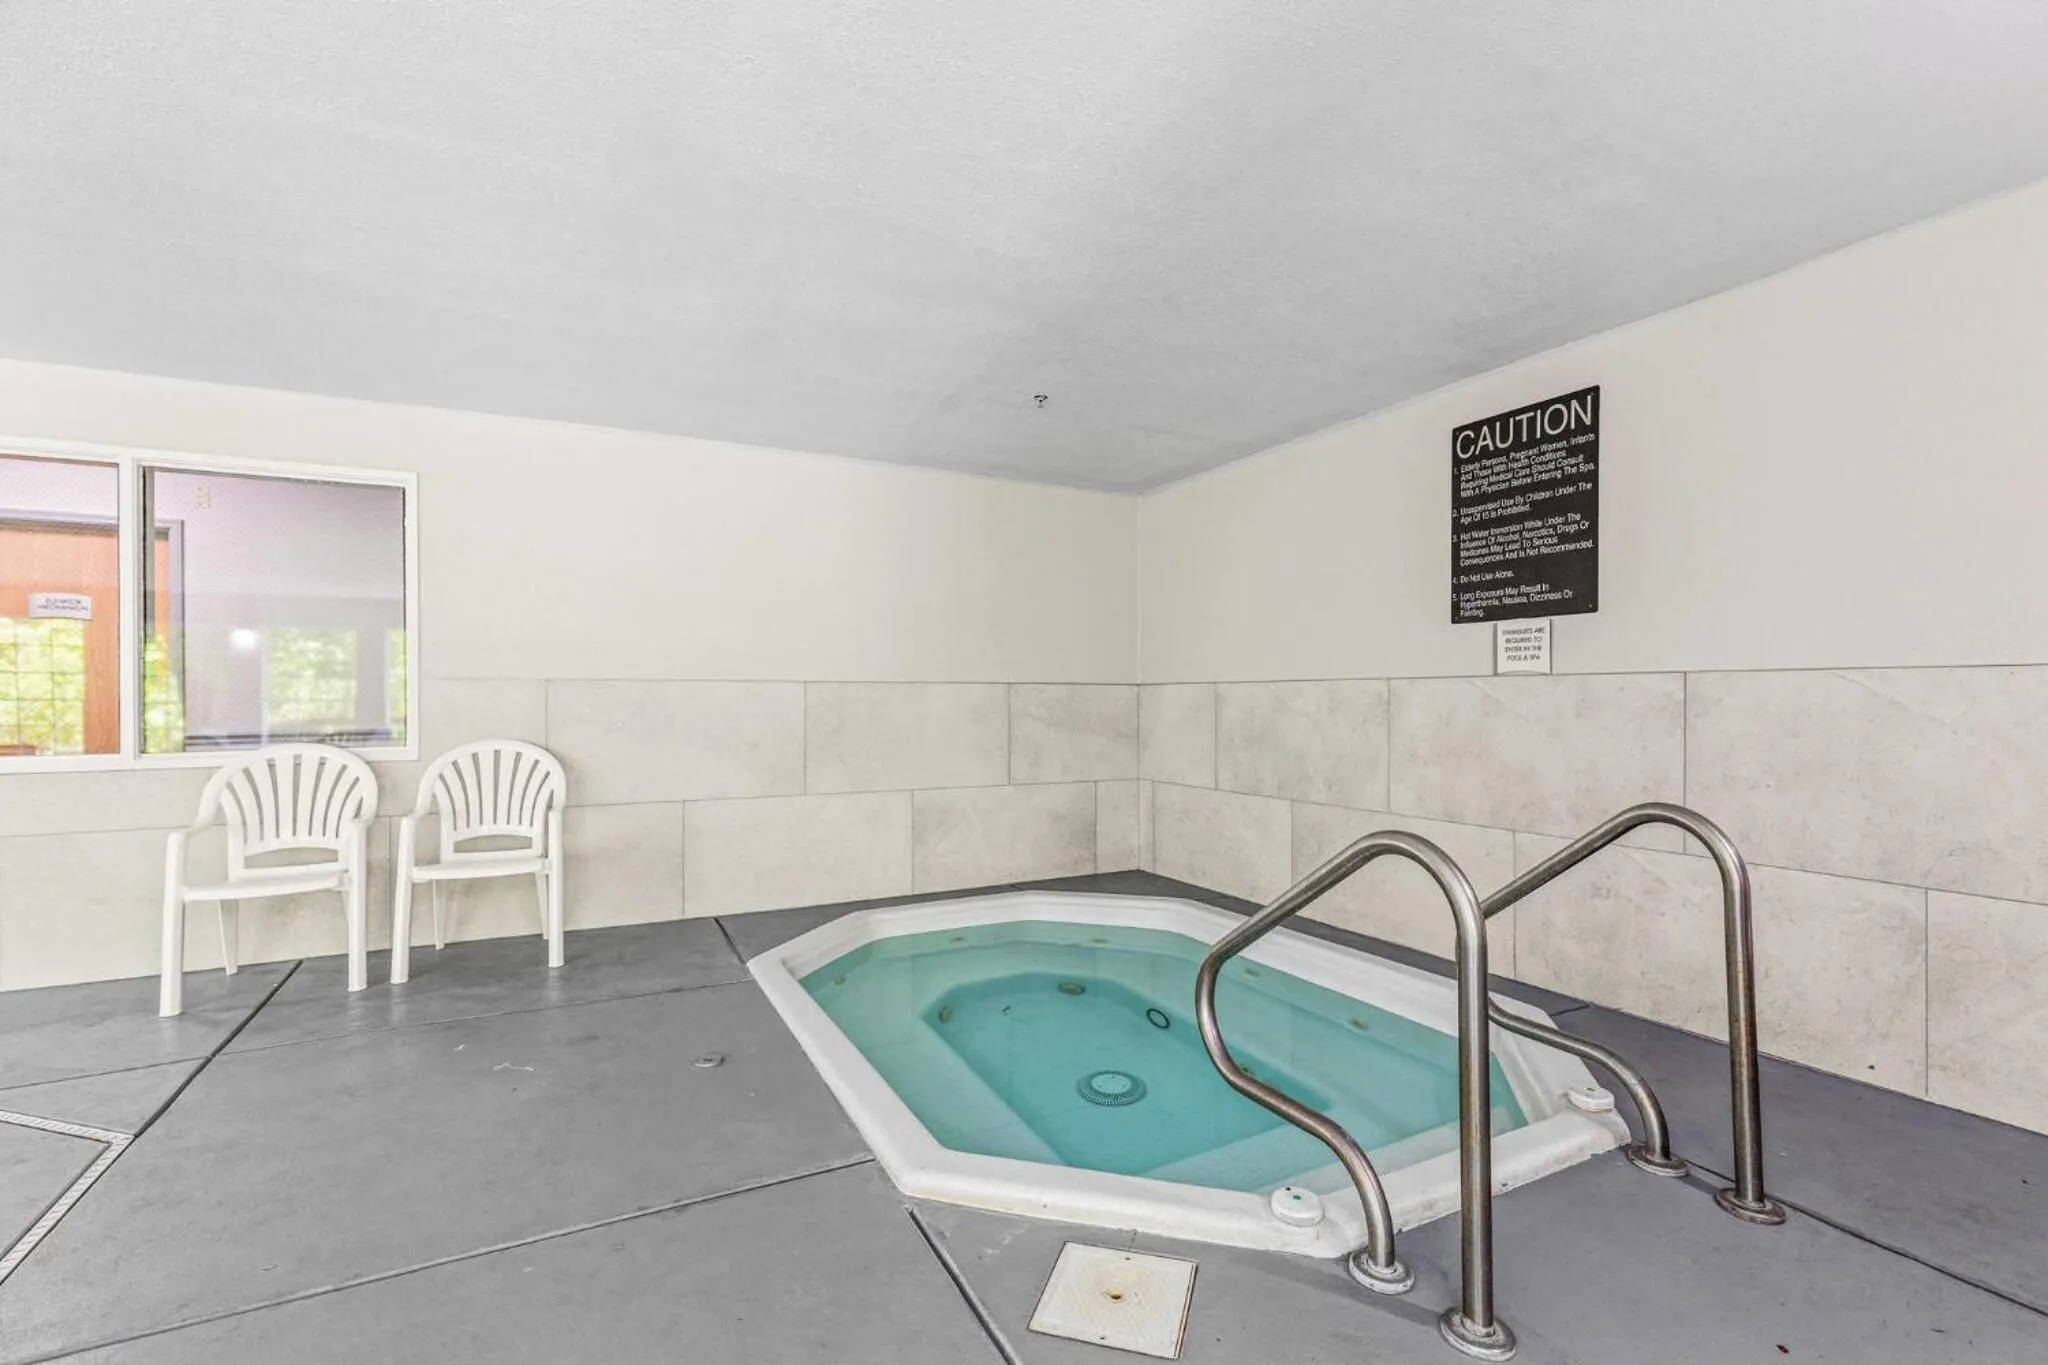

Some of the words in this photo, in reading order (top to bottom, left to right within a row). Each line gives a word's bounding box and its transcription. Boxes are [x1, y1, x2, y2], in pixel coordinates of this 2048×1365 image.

[1456, 395, 1592, 459] CAUTION
[1510, 446, 1539, 461] Pregnant
[1461, 471, 1472, 482] And
[1474, 469, 1492, 478] Those
[1493, 463, 1507, 473] With
[1508, 458, 1529, 470] Health
[1530, 450, 1567, 465] Conditions
[1461, 478, 1488, 490] Requiring
[1489, 471, 1513, 483] Medical
[1514, 467, 1531, 478] Care
[1532, 460, 1555, 474] Should
[1556, 454, 1584, 468] Consult
[1461, 489, 1473, 498] With
[1474, 487, 1480, 496] A
[1481, 481, 1510, 494] Physician
[1511, 476, 1532, 487] Before
[1533, 469, 1562, 482] Entering
[1563, 466, 1577, 475] The
[1461, 500, 1500, 515] Unsupervised
[1501, 498, 1514, 508] Use
[1515, 494, 1524, 505] By
[1525, 491, 1554, 503] Children
[1555, 485, 1577, 497] Under
[1578, 482, 1593, 492] The
[1461, 516, 1472, 525] Age
[1473, 512, 1481, 521] Of
[1491, 509, 1497, 518] Is
[1461, 532, 1471, 541] Hot
[1472, 530, 1489, 539] Water
[1490, 524, 1523, 536] Immersion
[1524, 519, 1543, 530] While
[1544, 514, 1566, 526] Under
[1567, 512, 1582, 523] The
[1461, 539, 1487, 549] Influence
[1488, 535, 1496, 545] Of
[1523, 527, 1556, 538] Narcotics,
[1557, 524, 1579, 534] Drugs
[1580, 520, 1590, 530] Or
[1461, 547, 1489, 558] Medicines
[1490, 545, 1504, 554] May
[1505, 542, 1521, 551] Lead
[1523, 539, 1532, 548] To
[1532, 536, 1558, 547] Serious
[1461, 554, 1504, 567] Consequences
[1505, 551, 1518, 560] And
[1519, 550, 1525, 558] Is
[1526, 548, 1539, 557] Not
[1540, 539, 1595, 555] Recommended.
[1461, 575, 1469, 583] Do
[1470, 573, 1480, 583] Not
[1481, 572, 1494, 581] Use
[1495, 569, 1515, 579] Alone.
[1461, 592, 1475, 602] Long
[1476, 589, 1504, 600] Exposure
[1505, 587, 1519, 596] May
[1520, 583, 1541, 594] Result
[1542, 582, 1550, 591] In
[1530, 591, 1562, 602] Dizziness
[1563, 589, 1573, 599] Or
[1504, 645, 1522, 653] ENTER
[1531, 644, 1542, 652] THE
[1505, 636, 1533, 644] REQUIRED
[1534, 635, 1543, 643] TO
[1506, 654, 1522, 662] POOL
[1529, 652, 1541, 661] SPA
